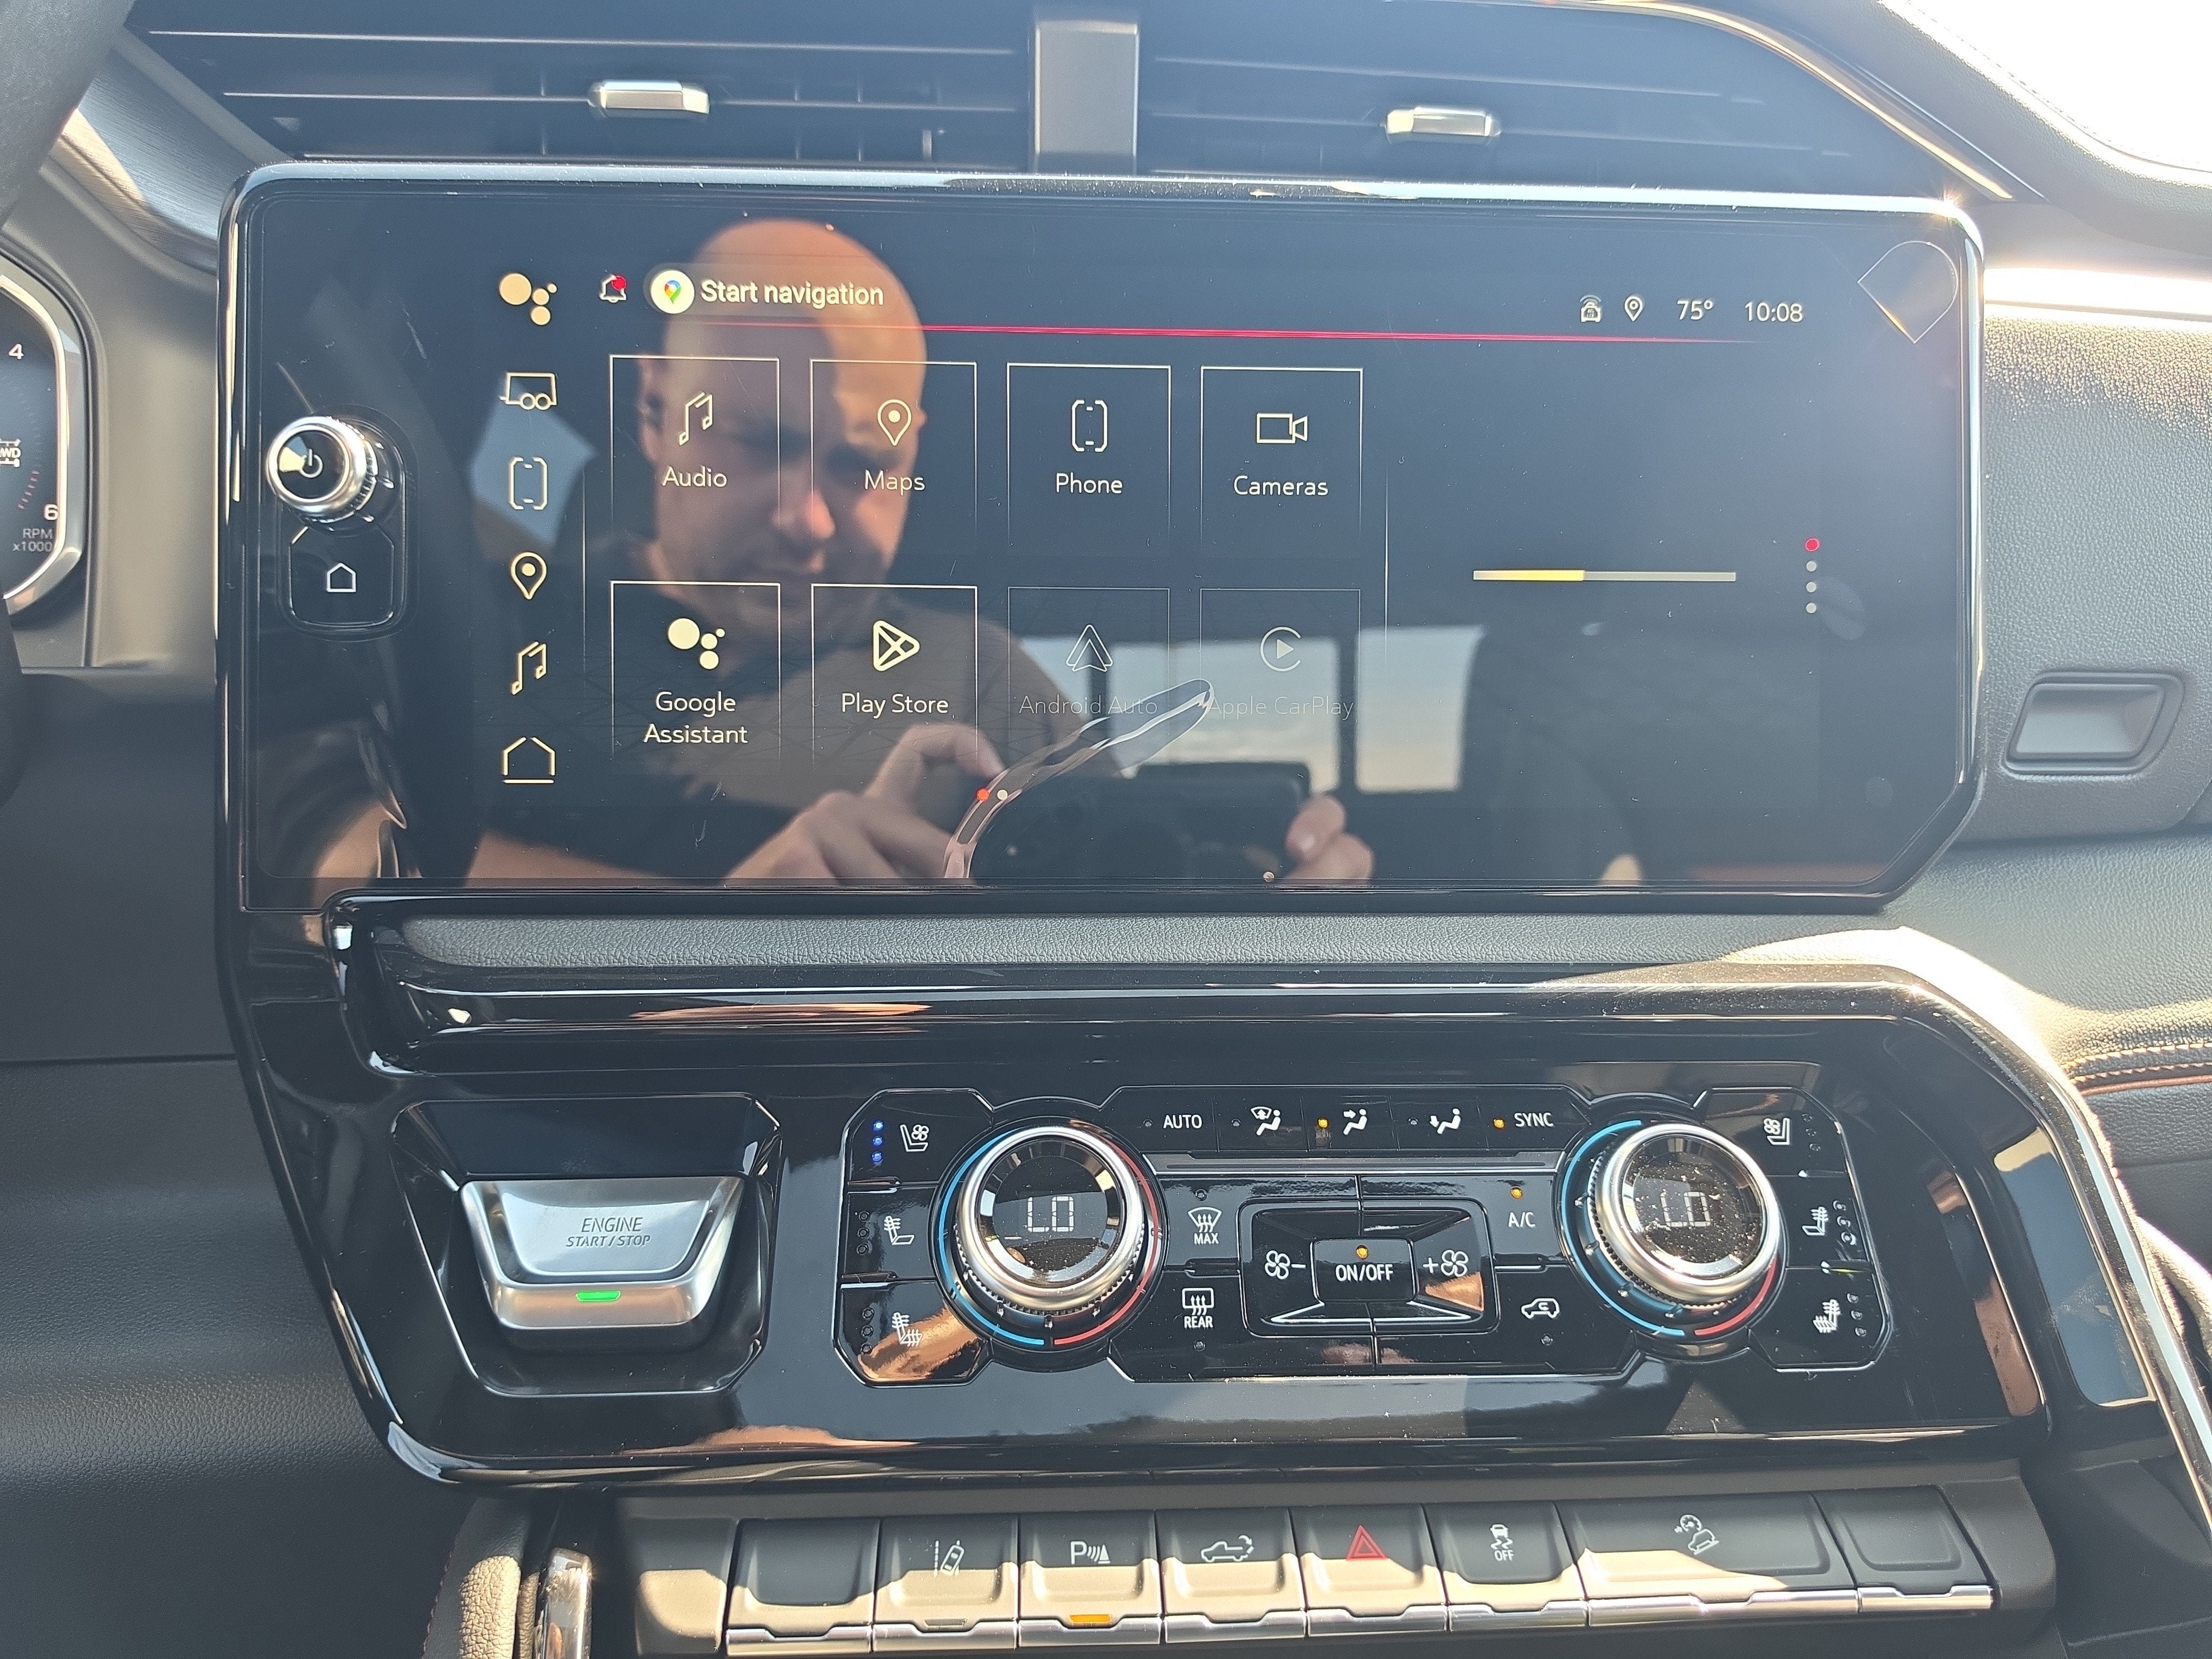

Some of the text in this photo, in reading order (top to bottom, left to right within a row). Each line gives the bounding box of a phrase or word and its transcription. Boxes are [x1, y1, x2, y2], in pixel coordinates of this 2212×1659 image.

[701, 279, 884, 307] Start navigation
[1745, 301, 1803, 322] 10:08
[8, 344, 24, 359] 4
[0, 448, 21, 458] WD
[662, 465, 727, 487] Audio
[865, 470, 925, 496] Maps
[1056, 472, 1123, 494] Phone
[1234, 475, 1328, 496] Cameras
[44, 504, 59, 520] 6
[23, 528, 52, 538] RPM
[12, 541, 53, 552] x1000
[655, 691, 736, 718] Google
[842, 692, 948, 719] Play Store
[1018, 694, 1158, 715] Android Auto
[1210, 696, 1354, 721] Apple CarPlay
[644, 723, 748, 743] Assistant
[1163, 1114, 1202, 1129] AUTO
[1514, 1112, 1554, 1127] SYNC
[581, 1217, 644, 1233] ENGINE
[1508, 1212, 1535, 1227] A/C
[1193, 1232, 1220, 1245] MAX
[1335, 1264, 1393, 1282] ON/OFF
[1184, 1315, 1214, 1329] REAR
[1494, 1549, 1514, 1561] OFF
